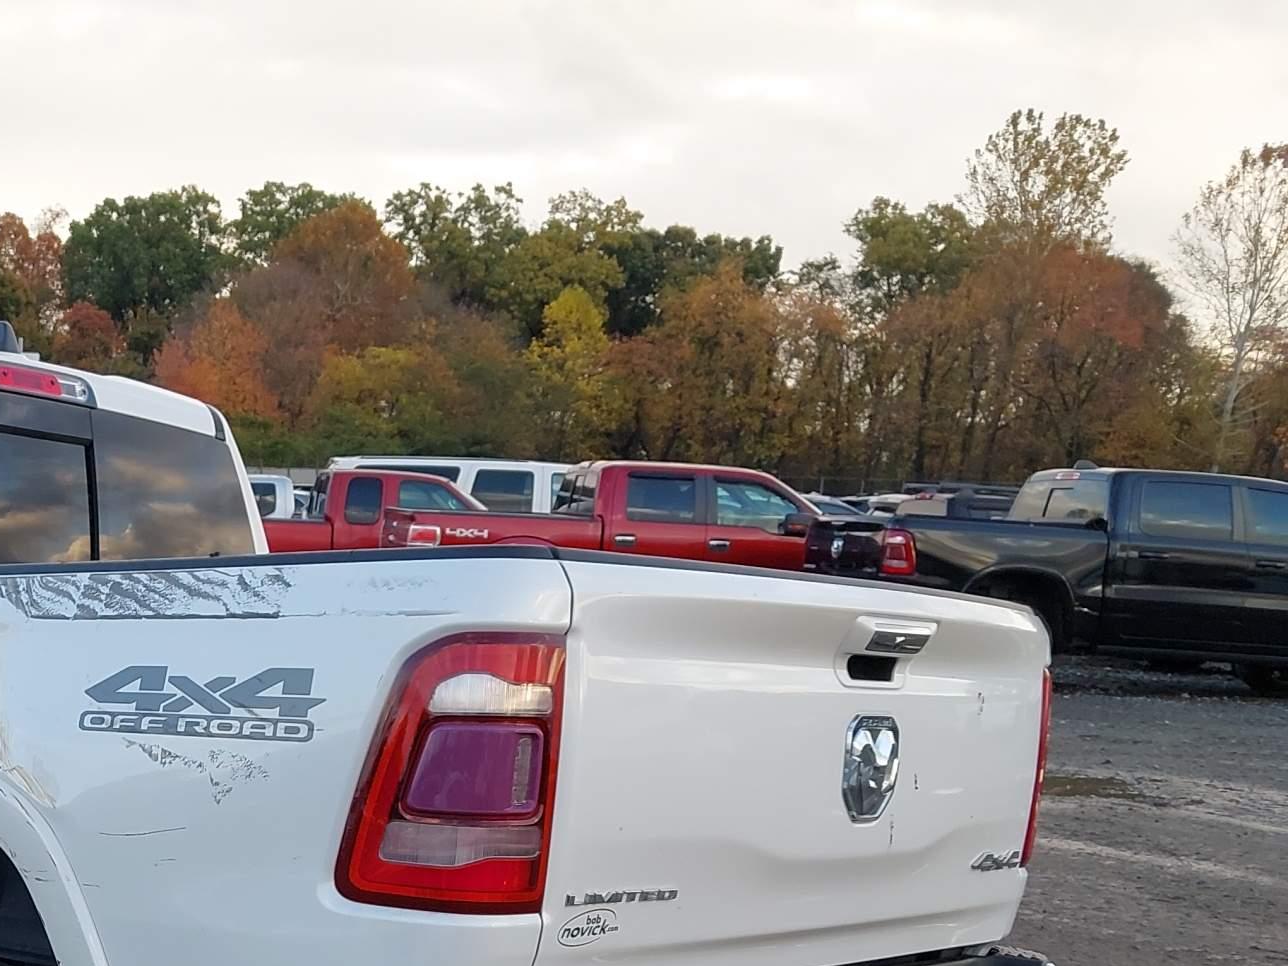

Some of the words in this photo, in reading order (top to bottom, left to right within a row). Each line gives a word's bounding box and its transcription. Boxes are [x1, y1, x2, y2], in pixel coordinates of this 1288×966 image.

[83, 713, 170, 730] OFF
[176, 717, 311, 738] ROAD
[564, 889, 679, 907] LIMITED
[585, 914, 602, 926] bob
